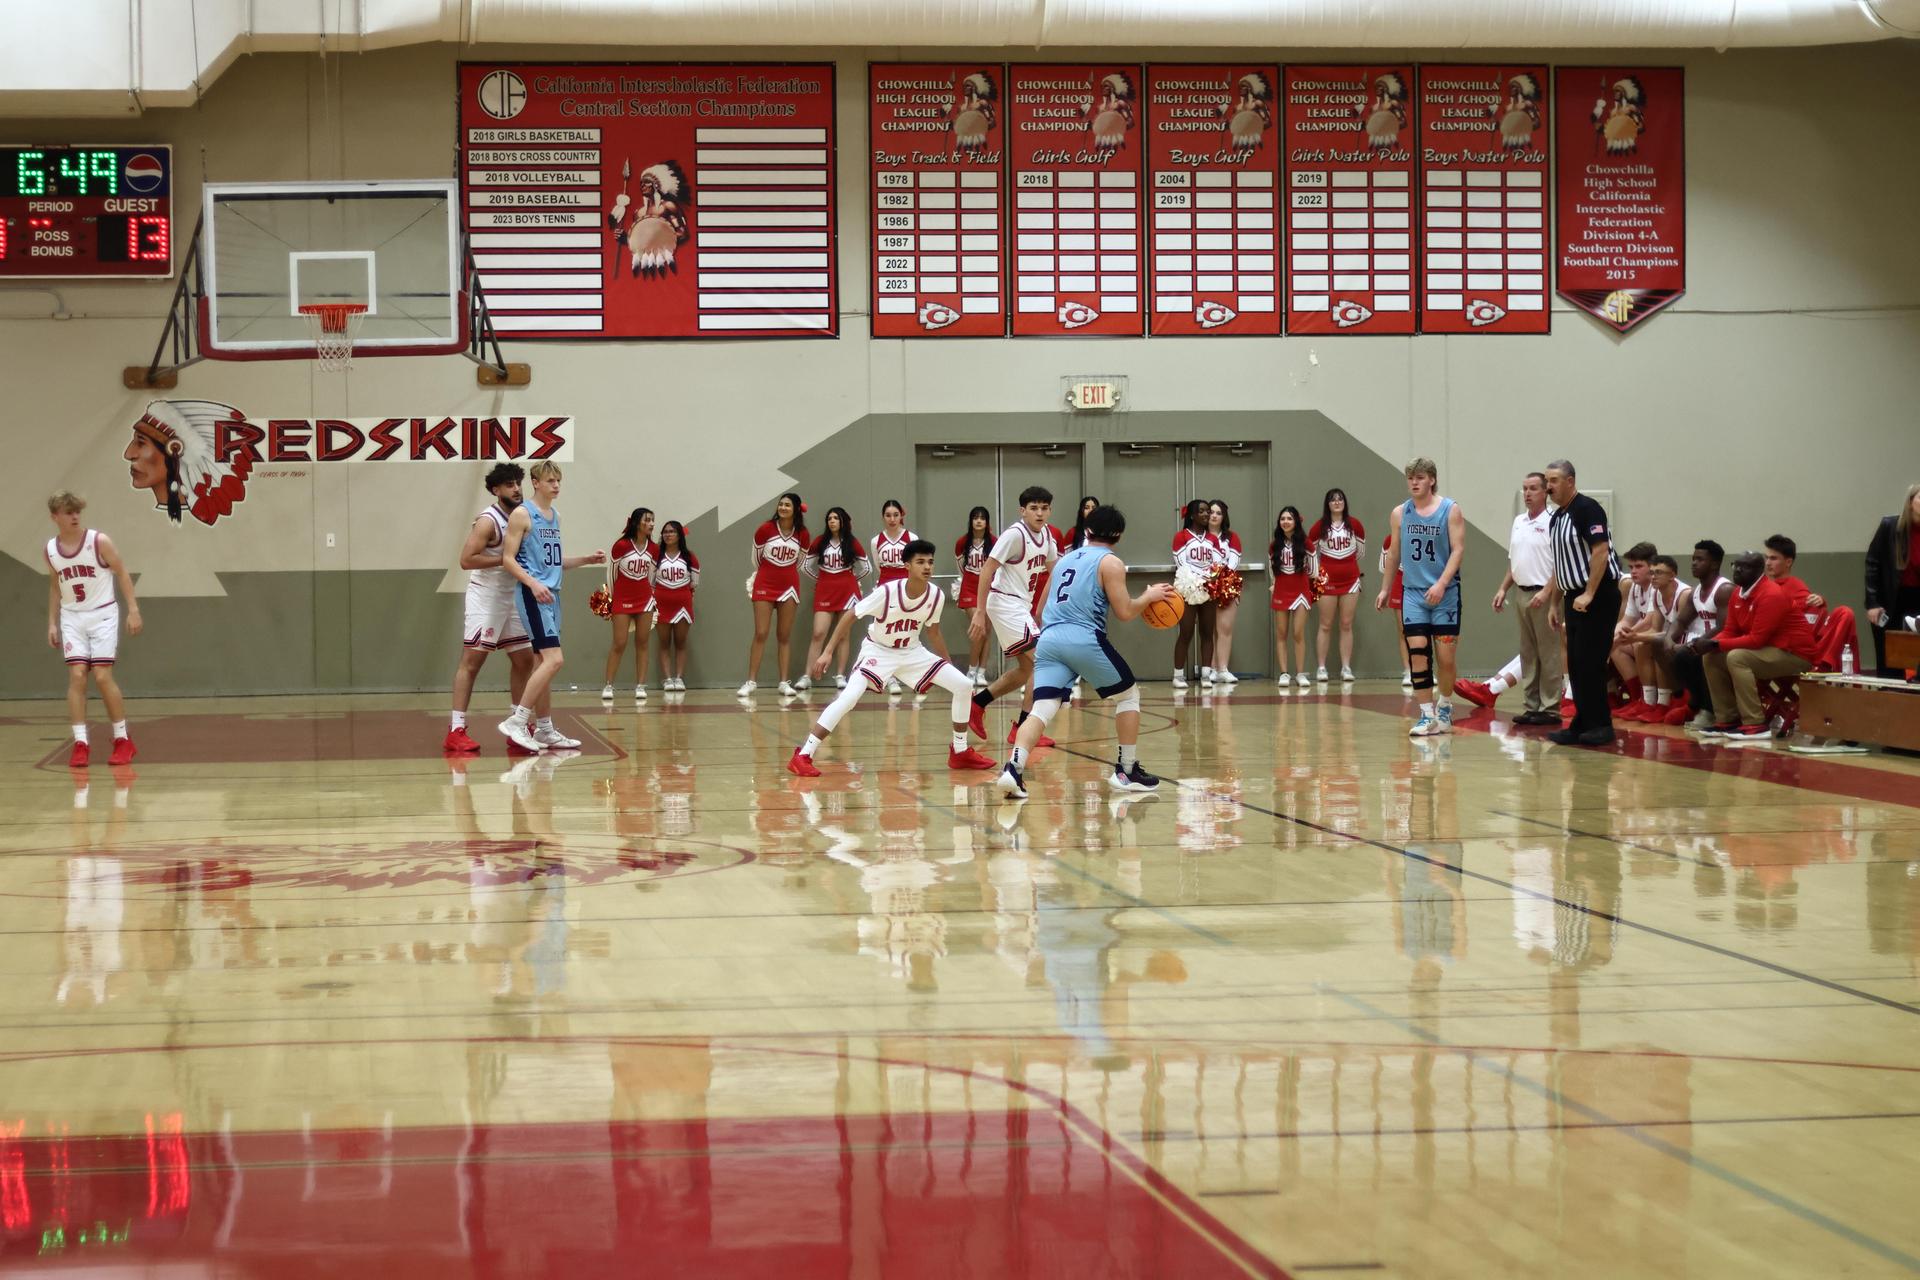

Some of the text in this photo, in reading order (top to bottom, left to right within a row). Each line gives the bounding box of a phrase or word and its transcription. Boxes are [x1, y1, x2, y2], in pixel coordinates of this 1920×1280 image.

[534, 75, 820, 94] California Interscholastic Federation
[878, 80, 954, 90] CHOWCHILLA
[1017, 80, 1092, 90] CHOWCHILLA
[1155, 80, 1230, 90] CHOWCHILLA
[1291, 80, 1366, 90] CHOWCHILLA
[1426, 80, 1500, 90] CHOWCHILLA
[876, 94, 956, 104] HIGH SCHOOL
[1016, 94, 1094, 104] HIGH SCHOOL
[1153, 94, 1232, 104] HIGH SCHOOL
[1290, 94, 1368, 104] HIGH SCHOOL
[1425, 94, 1502, 104] HIGH SCHOOL
[560, 98, 796, 120] Central Section Champions
[894, 108, 938, 118] LEAGUE
[1032, 108, 1077, 118] LEAGUE
[1170, 108, 1215, 118] LEAGUE
[1307, 108, 1351, 118] LEAGUE
[1442, 108, 1485, 118] LEAGUE
[881, 121, 950, 132] CHAMPIONS
[1020, 121, 1089, 132] CHAMPIONS
[1158, 121, 1226, 132] CHAMPIONS
[1296, 121, 1362, 132] CHAMPIONS
[1430, 121, 1496, 132] CHAMPIONS
[473, 131, 594, 142] 2018 GIRLS BASKETBALL
[470, 151, 596, 162] 2018 BOYS CROSS COUNTRY
[875, 150, 906, 166] Boys
[911, 150, 948, 164] Track
[968, 150, 1000, 164] Field
[1032, 150, 1116, 166] Girls Golf
[1169, 149, 1255, 166] Boys Golf
[1291, 149, 1325, 162] Girls
[1376, 149, 1410, 162] Polo
[1424, 149, 1458, 166] Boys
[1512, 149, 1545, 163] Polo
[18, 152, 118, 195] 6:49
[1586, 164, 1654, 175] Chowchilla
[485, 172, 585, 183] 2018 VOLLEYBALL
[882, 175, 908, 185] 1978
[1023, 175, 1048, 185] 2018
[1160, 174, 1185, 185] 2004
[1297, 174, 1322, 184] 2019
[1584, 177, 1656, 190] High School
[489, 194, 581, 205] 2019 BASEBALL
[882, 196, 908, 206] 1982
[1160, 195, 1186, 205] 2019
[1297, 195, 1322, 205] 2022
[1590, 190, 1652, 201] California
[29, 201, 74, 213] PERIOD
[104, 198, 159, 213] GUEST
[1576, 204, 1665, 214] Interscholastic
[492, 214, 576, 225] 2023 BOYS TENNIS
[883, 216, 909, 226] 1986
[1588, 217, 1653, 227] Federation
[35, 231, 70, 242] POSS
[128, 216, 169, 260] 13
[1582, 230, 1659, 240] Division 4-A
[883, 238, 909, 248] 1987
[1568, 243, 1674, 254] Southern Divison
[31, 246, 74, 257] BONUS
[885, 259, 908, 269] 2022
[1563, 256, 1679, 270] Football Champions
[1606, 270, 1636, 280] 2015
[885, 280, 908, 290] 2023
[1082, 385, 1106, 404] EXIT
[213, 416, 571, 464] REDSKINS
[1407, 524, 1441, 536] YOSEMITE
[1327, 537, 1351, 551] CUHS
[544, 542, 562, 567] 30
[771, 546, 796, 562] CUHS
[1190, 548, 1212, 562] CUHS
[1410, 538, 1436, 562] 34
[627, 559, 650, 575] CUHS
[57, 564, 97, 583] TRIBE
[661, 566, 685, 583] CUHS
[1056, 568, 1076, 604] 2
[72, 584, 86, 602] 5
[885, 618, 922, 635] TRIB
